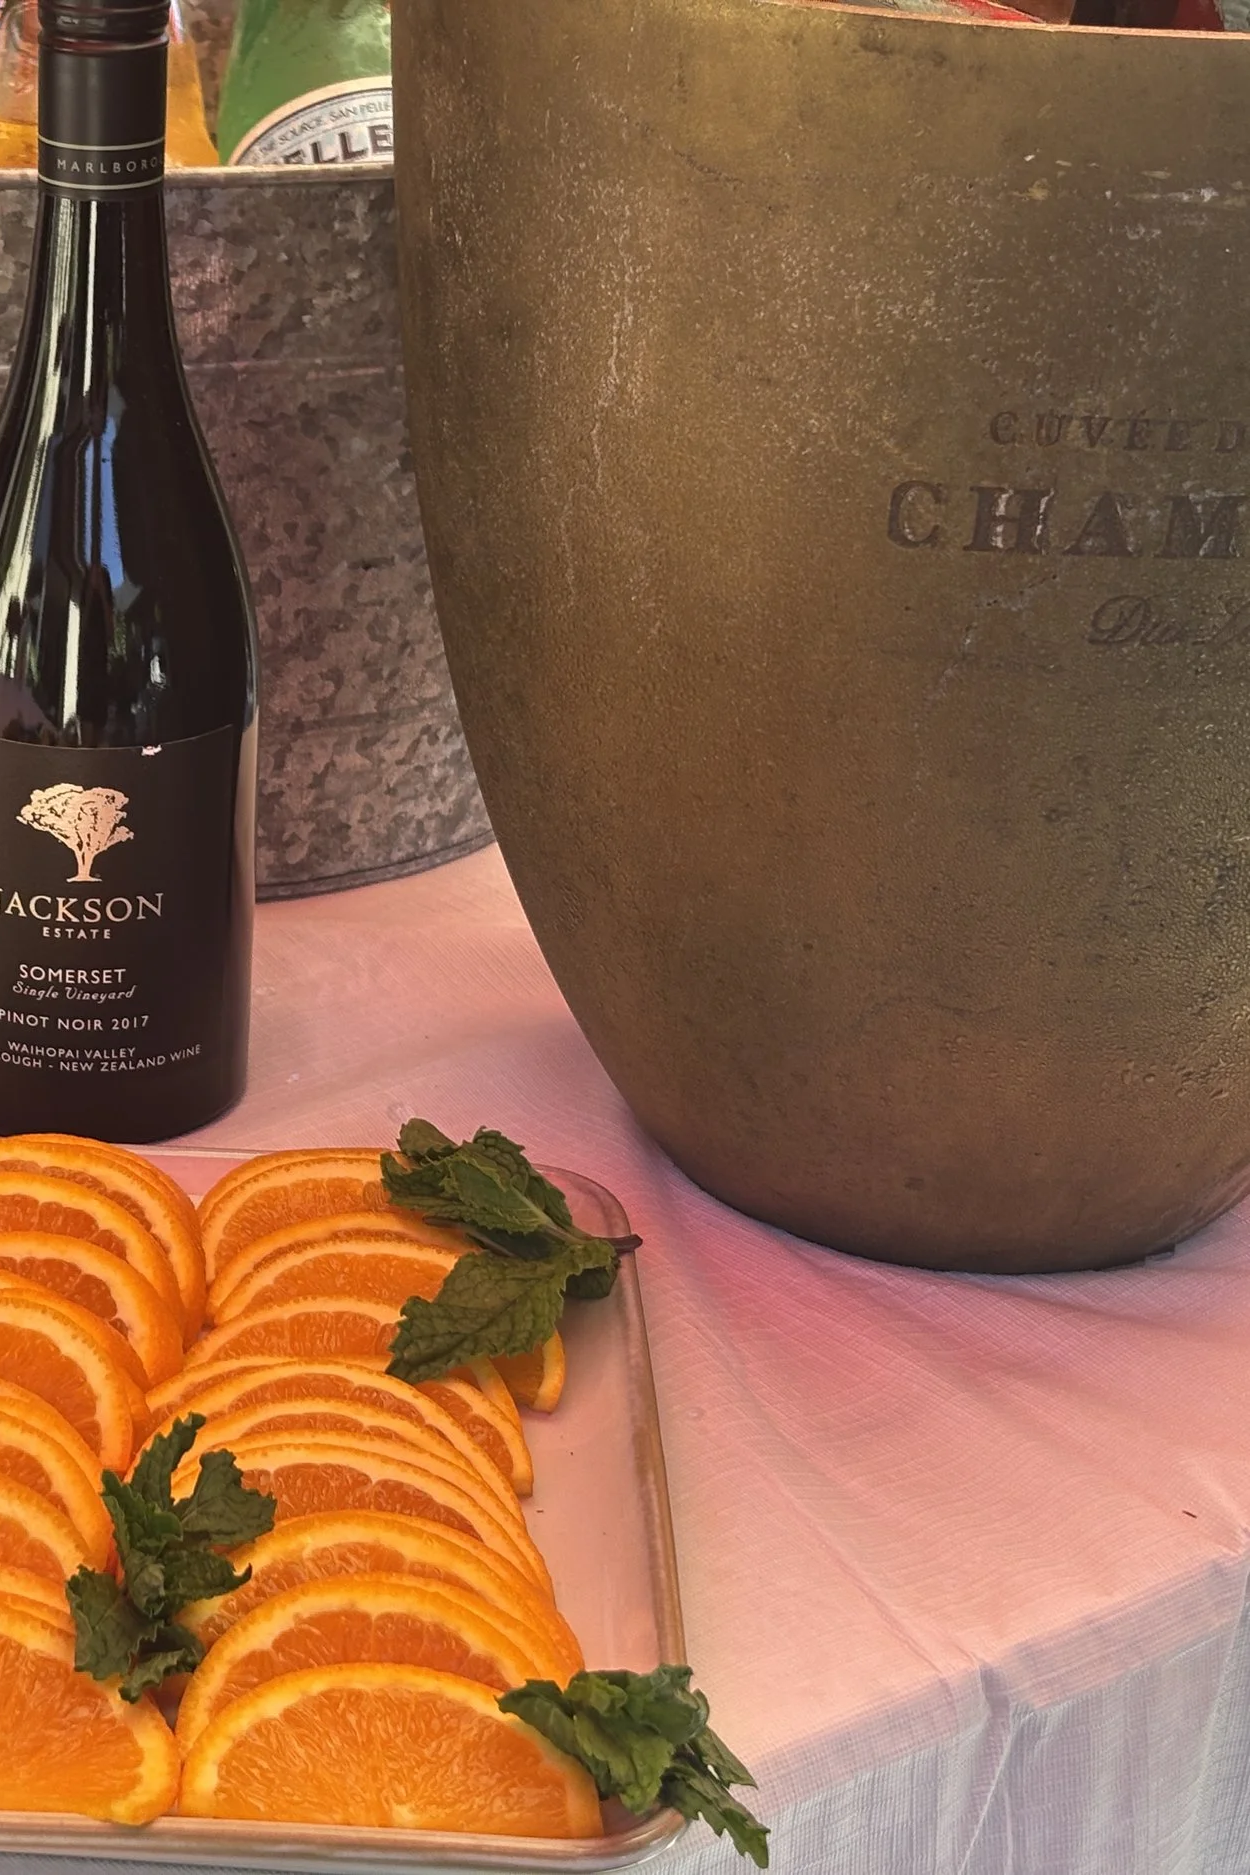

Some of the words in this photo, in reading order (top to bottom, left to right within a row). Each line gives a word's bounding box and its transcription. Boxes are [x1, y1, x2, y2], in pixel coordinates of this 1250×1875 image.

[887, 479, 1250, 560] CHAM
[42, 926, 111, 940] ESTATE
[19, 964, 127, 985] SOMERSET
[12, 981, 59, 1001] Single
[65, 985, 137, 1004] Vineyard
[58, 1018, 103, 1031] NOIR
[112, 1015, 149, 1031] 2017
[7, 1041, 80, 1059] WAIHOPAI
[85, 1047, 136, 1060] VALLEY
[60, 1061, 94, 1072] NEW
[100, 1055, 166, 1072] ZEALAND
[170, 1043, 203, 1063] WINE
